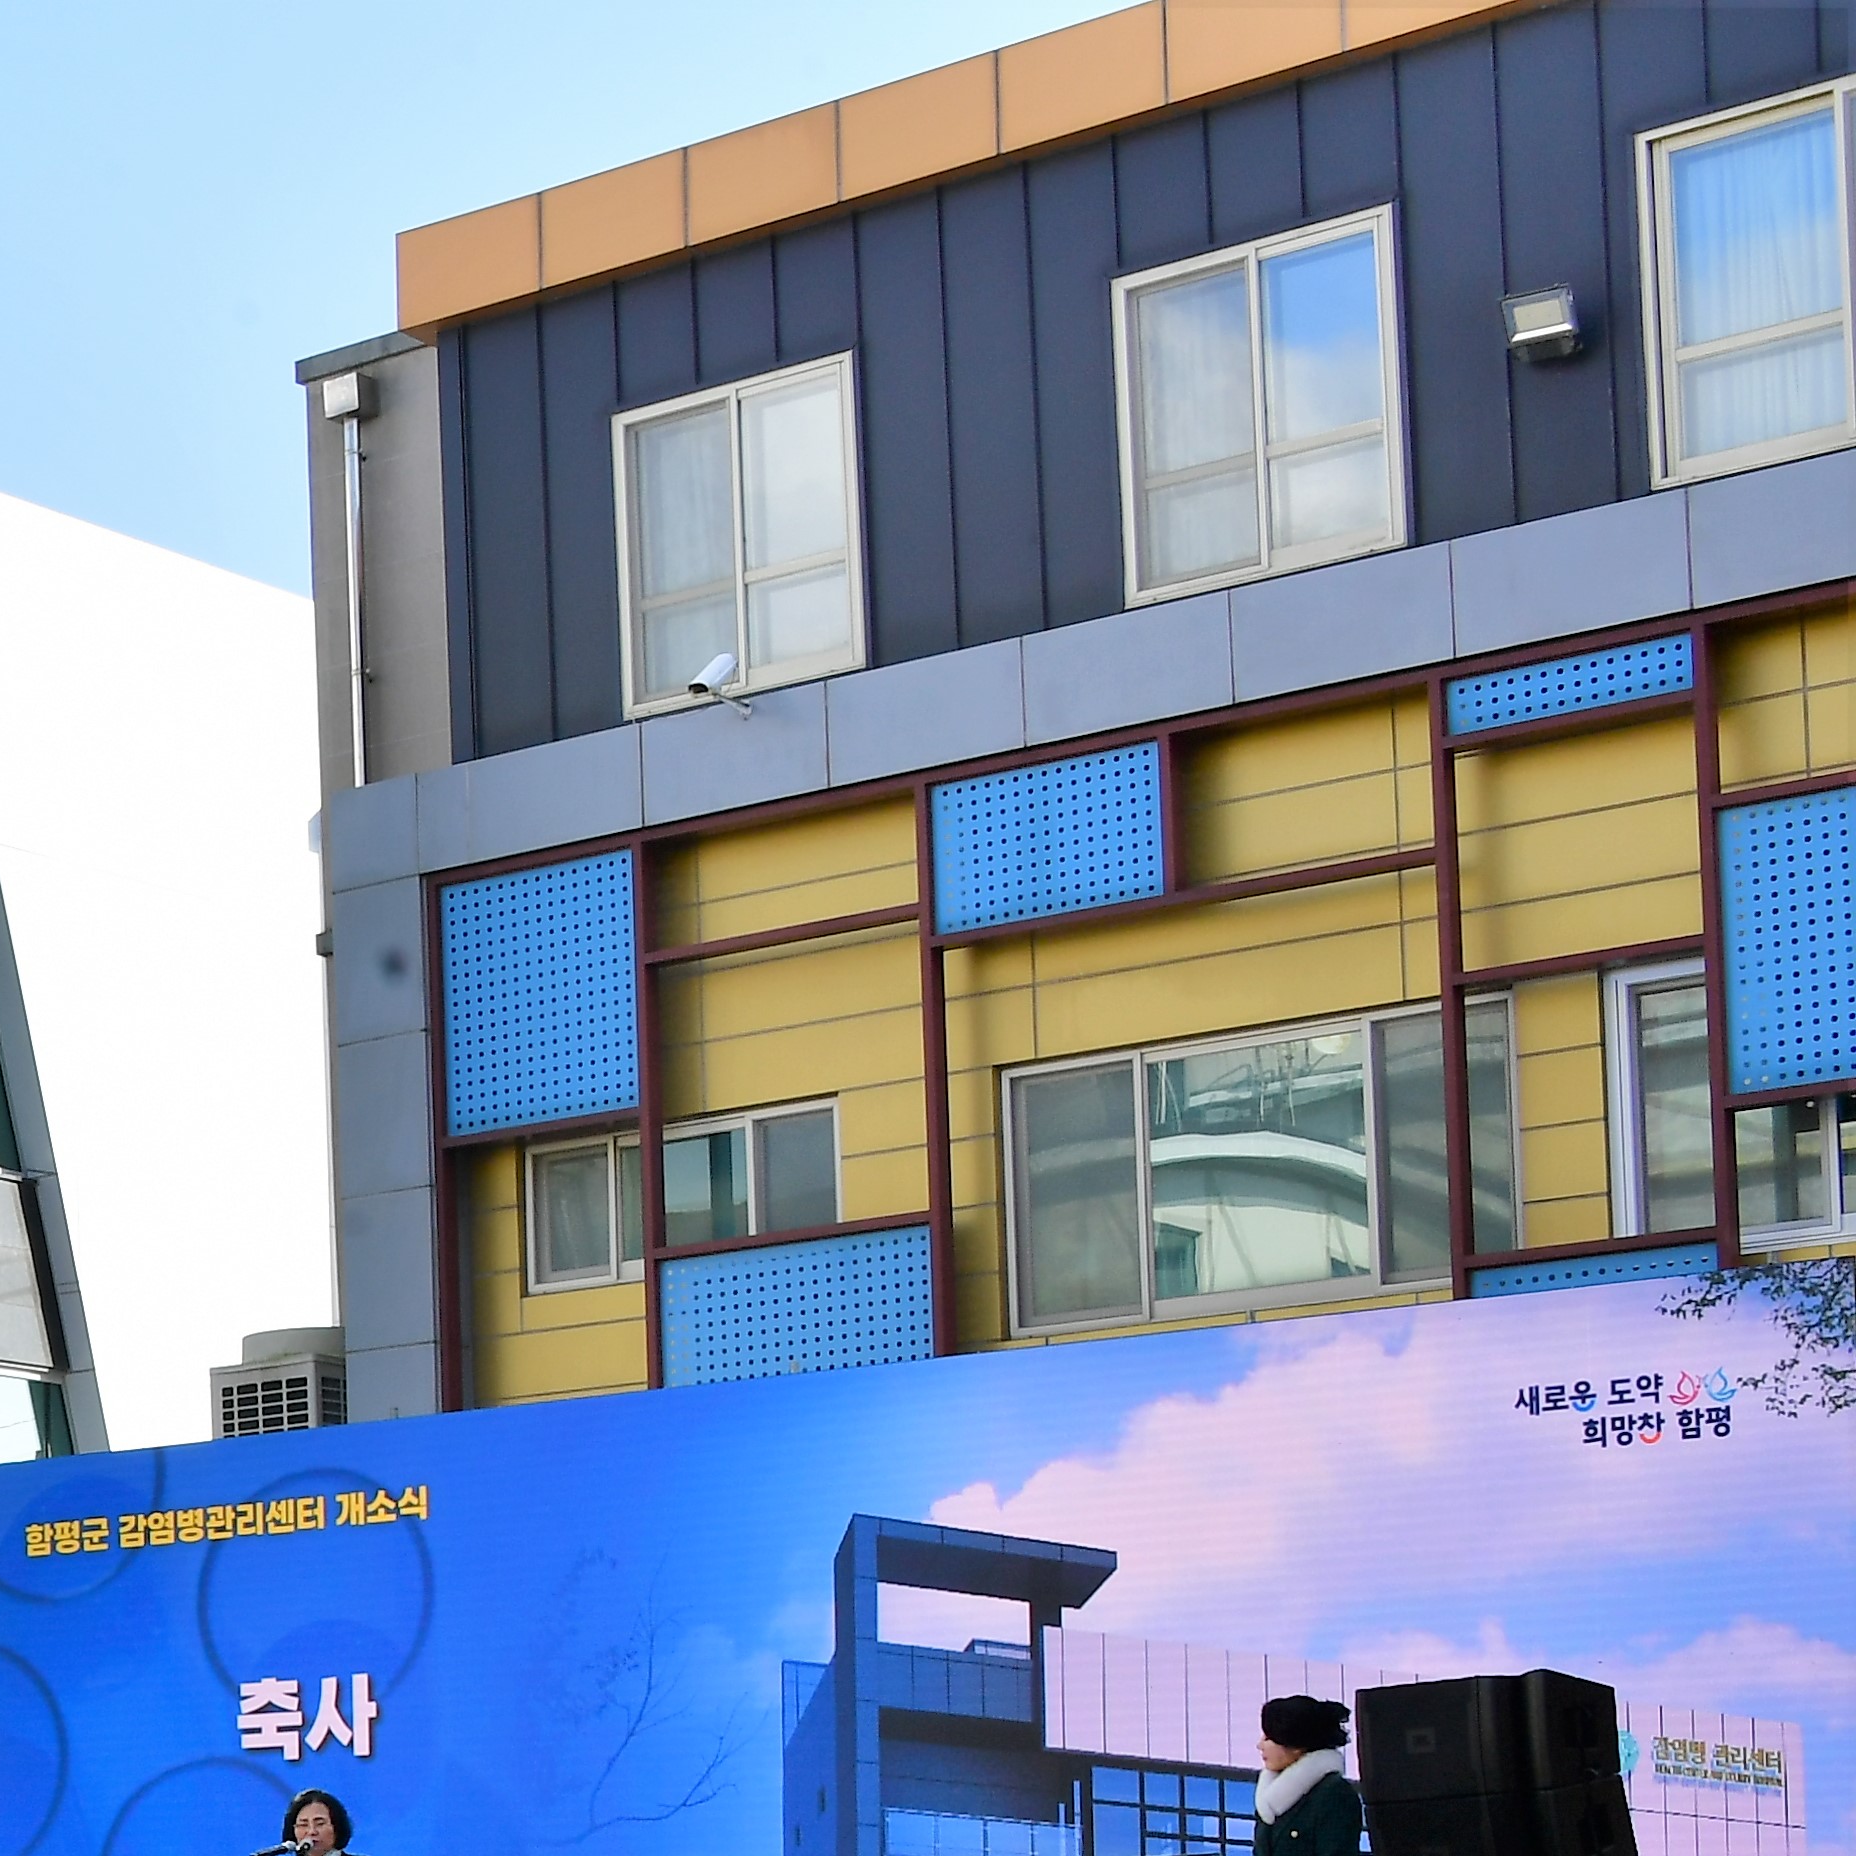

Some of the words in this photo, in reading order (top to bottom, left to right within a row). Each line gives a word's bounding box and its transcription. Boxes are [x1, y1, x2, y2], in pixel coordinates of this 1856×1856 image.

[1515, 1380, 1597, 1415] 새로운
[1607, 1373, 1664, 1406] 도약
[1582, 1411, 1665, 1447] 희망찬
[1676, 1405, 1731, 1440] 함평
[25, 1516, 110, 1557] 함평군
[118, 1495, 326, 1549] 감염병관리센터
[335, 1485, 429, 1527] 개소식
[237, 1672, 378, 1760] 축사
